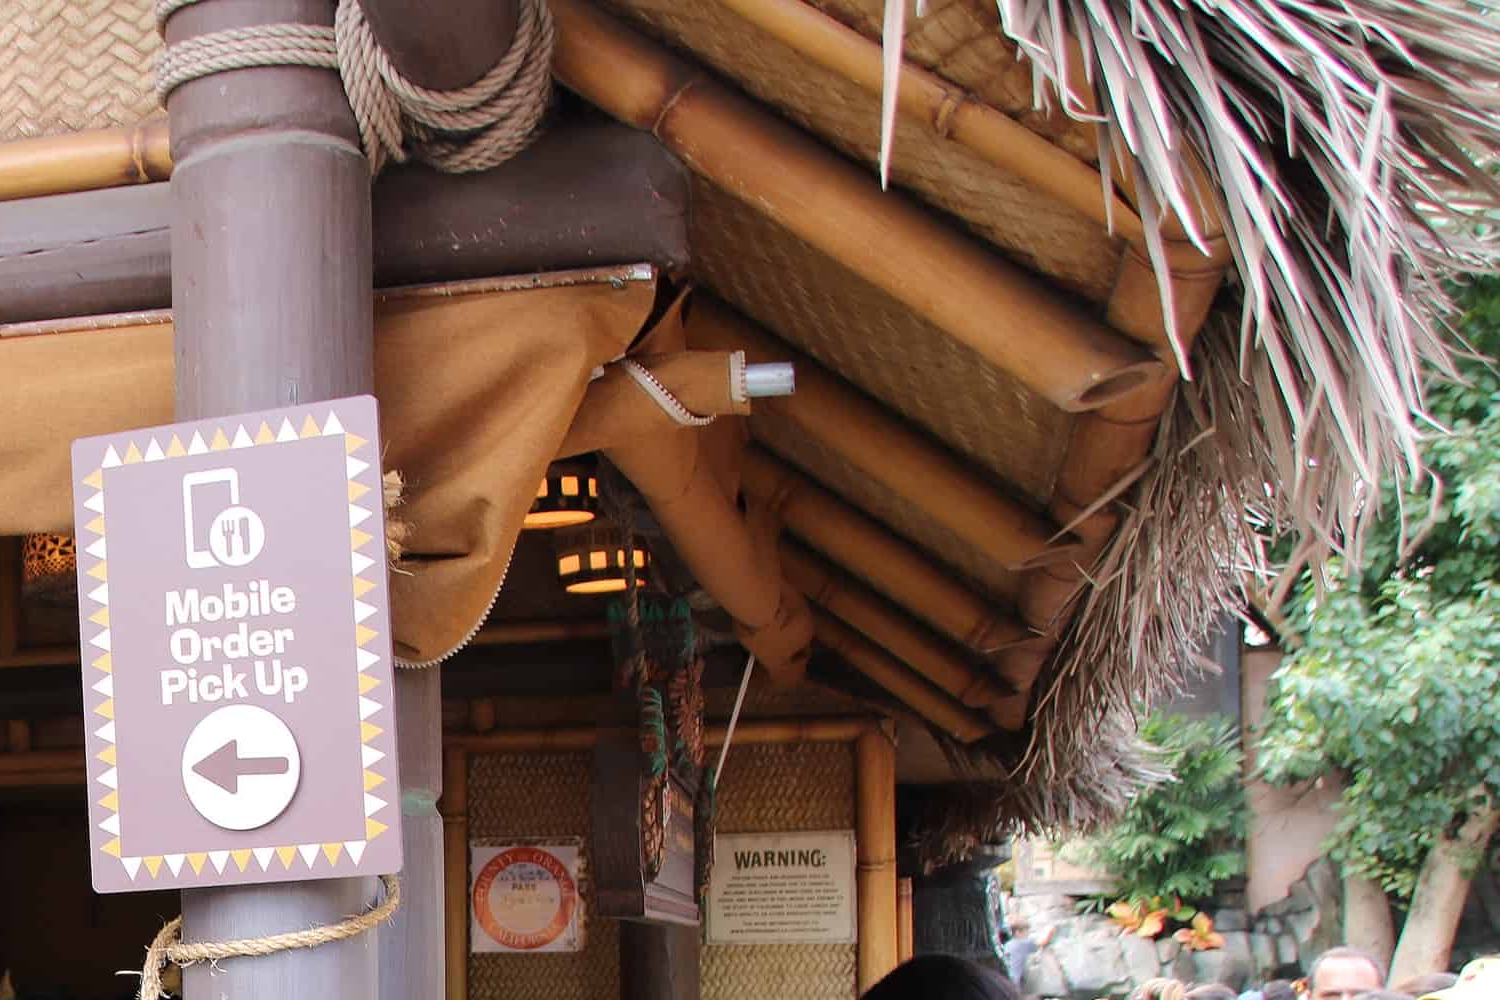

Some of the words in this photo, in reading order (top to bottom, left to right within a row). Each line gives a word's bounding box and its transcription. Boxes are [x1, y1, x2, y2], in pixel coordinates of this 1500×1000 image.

[165, 579, 296, 626] Mobile
[170, 622, 294, 664] Order
[160, 663, 246, 705] Pick
[254, 659, 308, 703] Up
[733, 848, 827, 871] WARNING:
